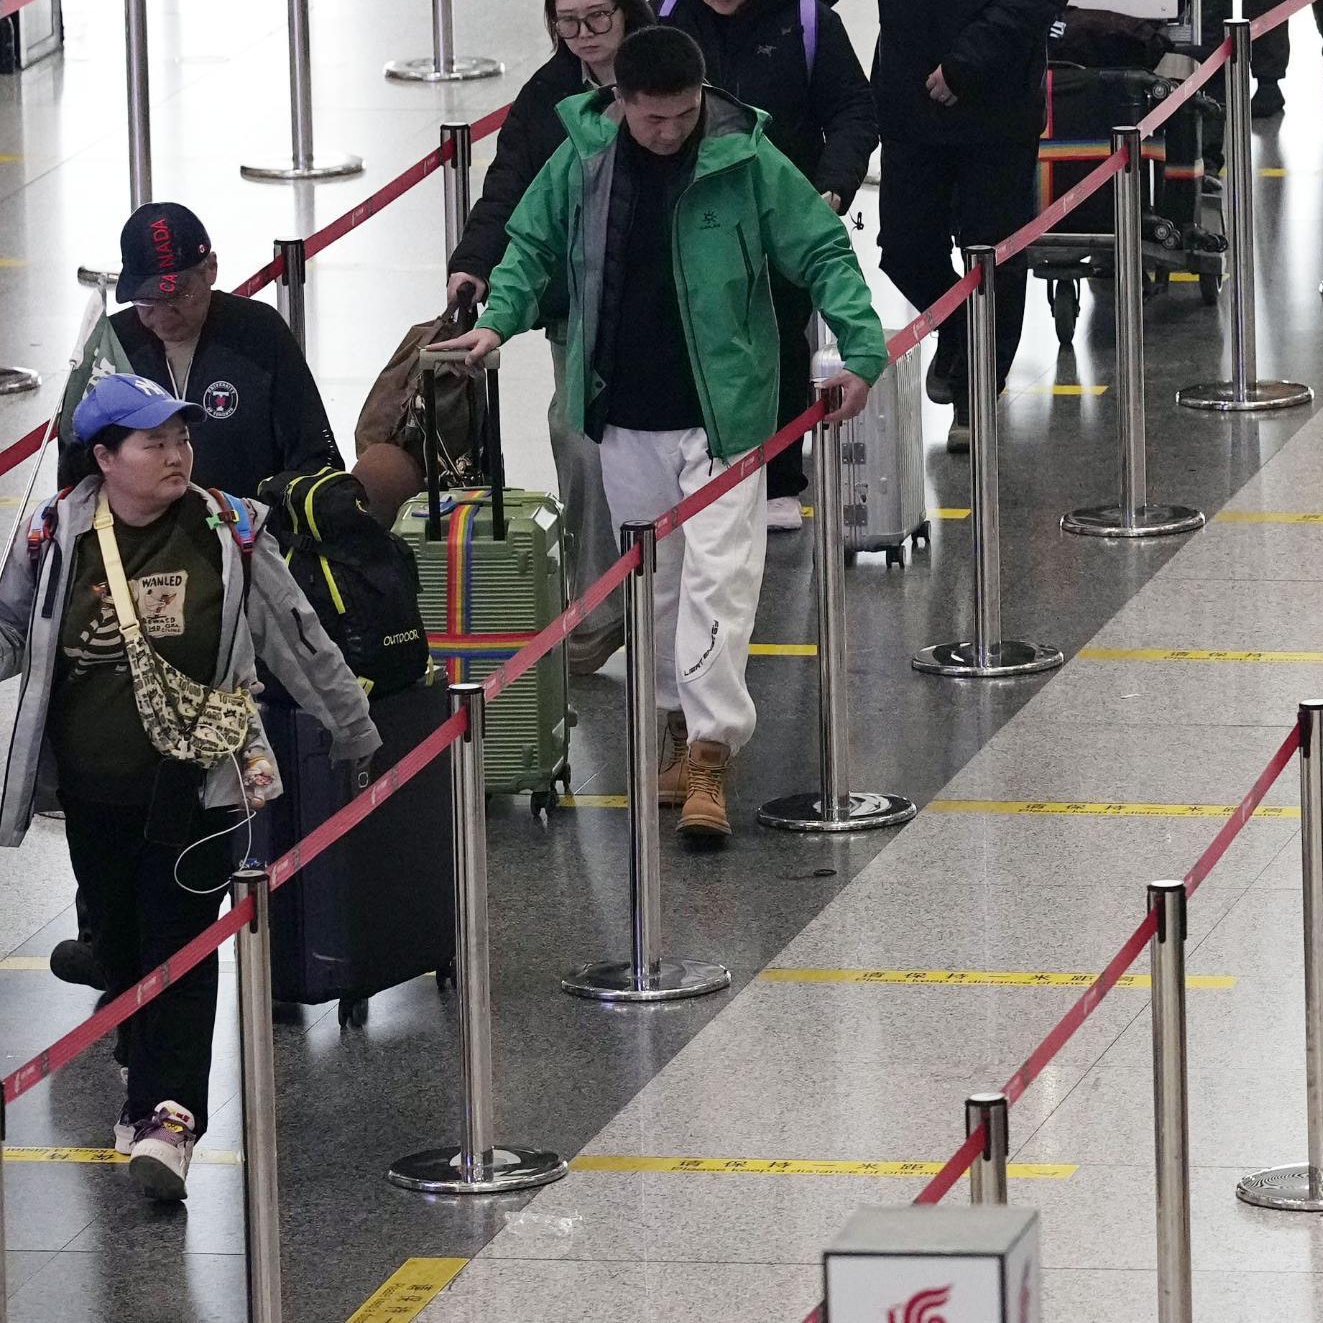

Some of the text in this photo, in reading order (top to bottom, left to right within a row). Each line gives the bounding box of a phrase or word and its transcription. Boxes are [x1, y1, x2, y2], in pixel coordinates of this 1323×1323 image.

[150, 217, 180, 294] CANADA
[383, 629, 420, 646] OUTDOOR
[679, 1160, 925, 1170] 请保持一米距
